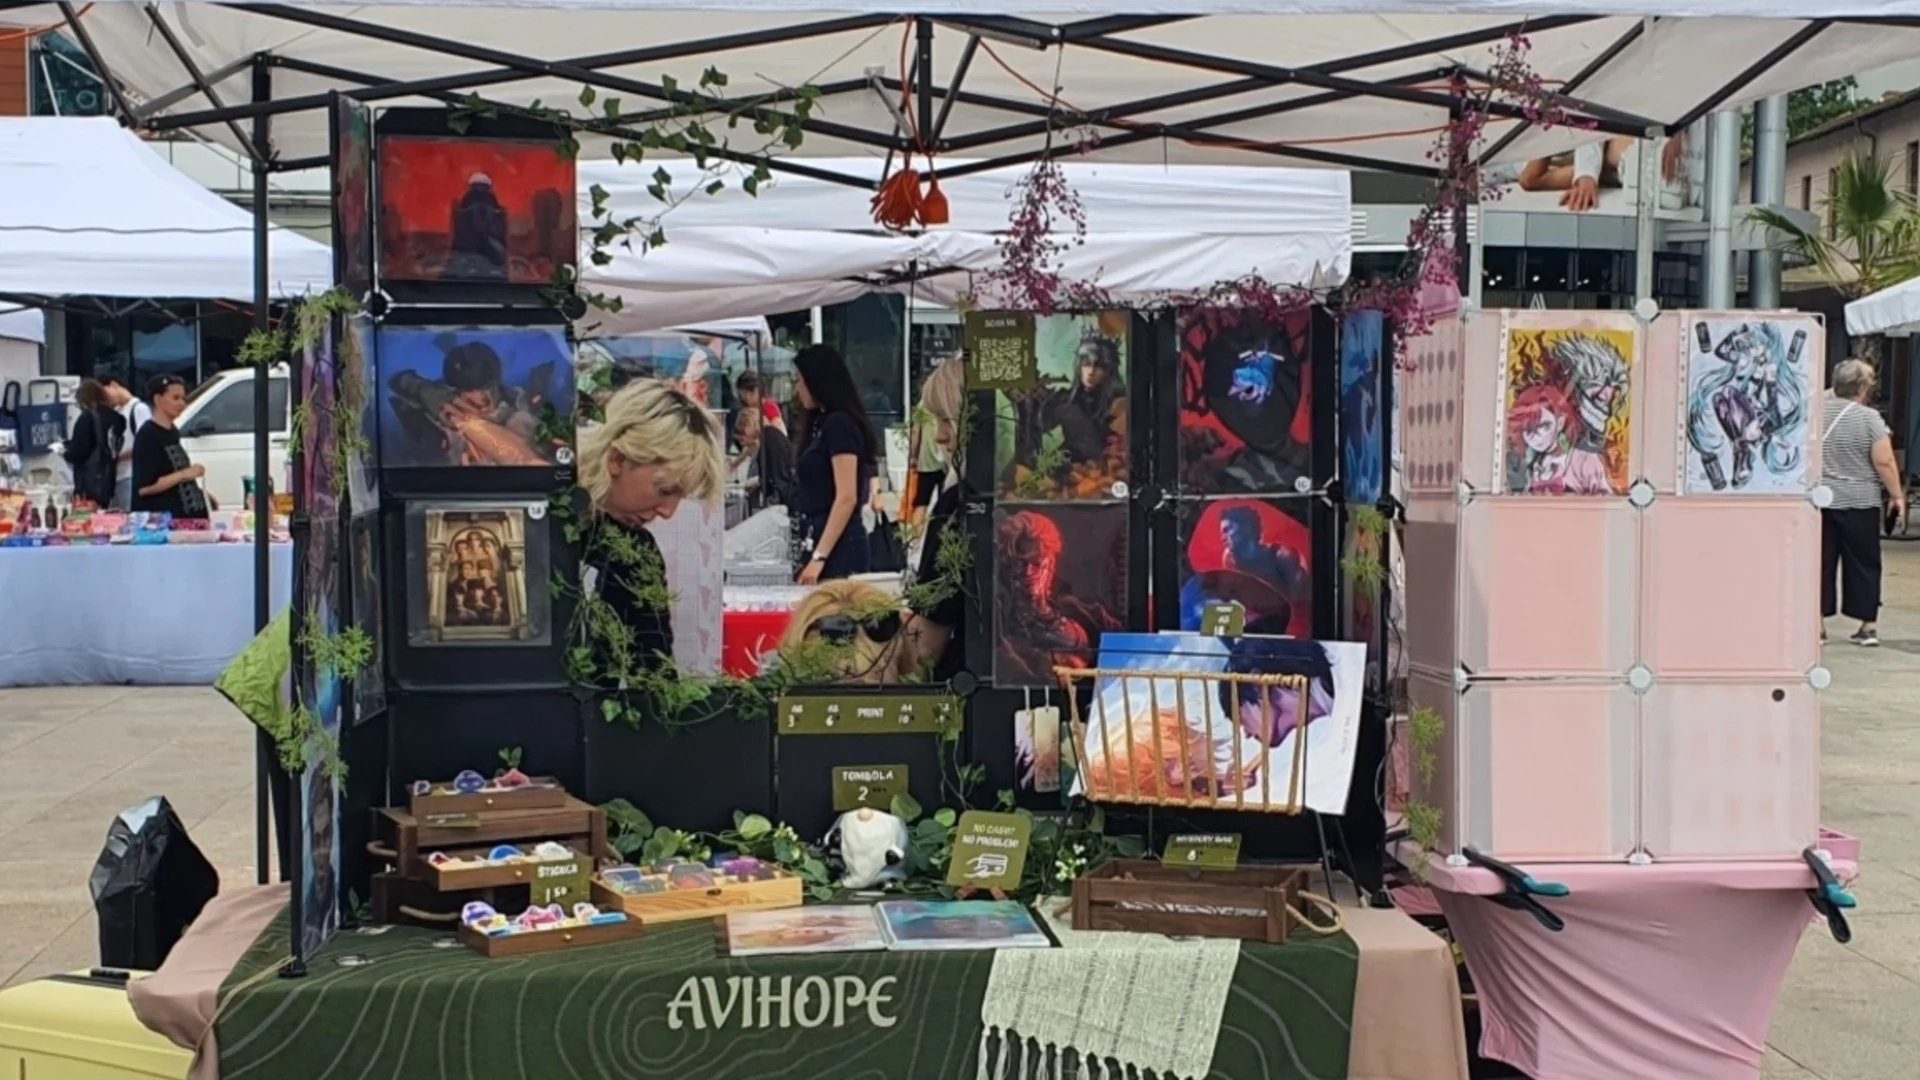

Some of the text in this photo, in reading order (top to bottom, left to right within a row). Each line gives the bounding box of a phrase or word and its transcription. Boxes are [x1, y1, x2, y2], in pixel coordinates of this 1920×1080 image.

[857, 707, 884, 718] PRINT
[842, 770, 894, 782] TOMBOLA
[973, 823, 986, 833] NO
[962, 834, 976, 844] NO
[666, 975, 898, 1030] AVIHOPE
